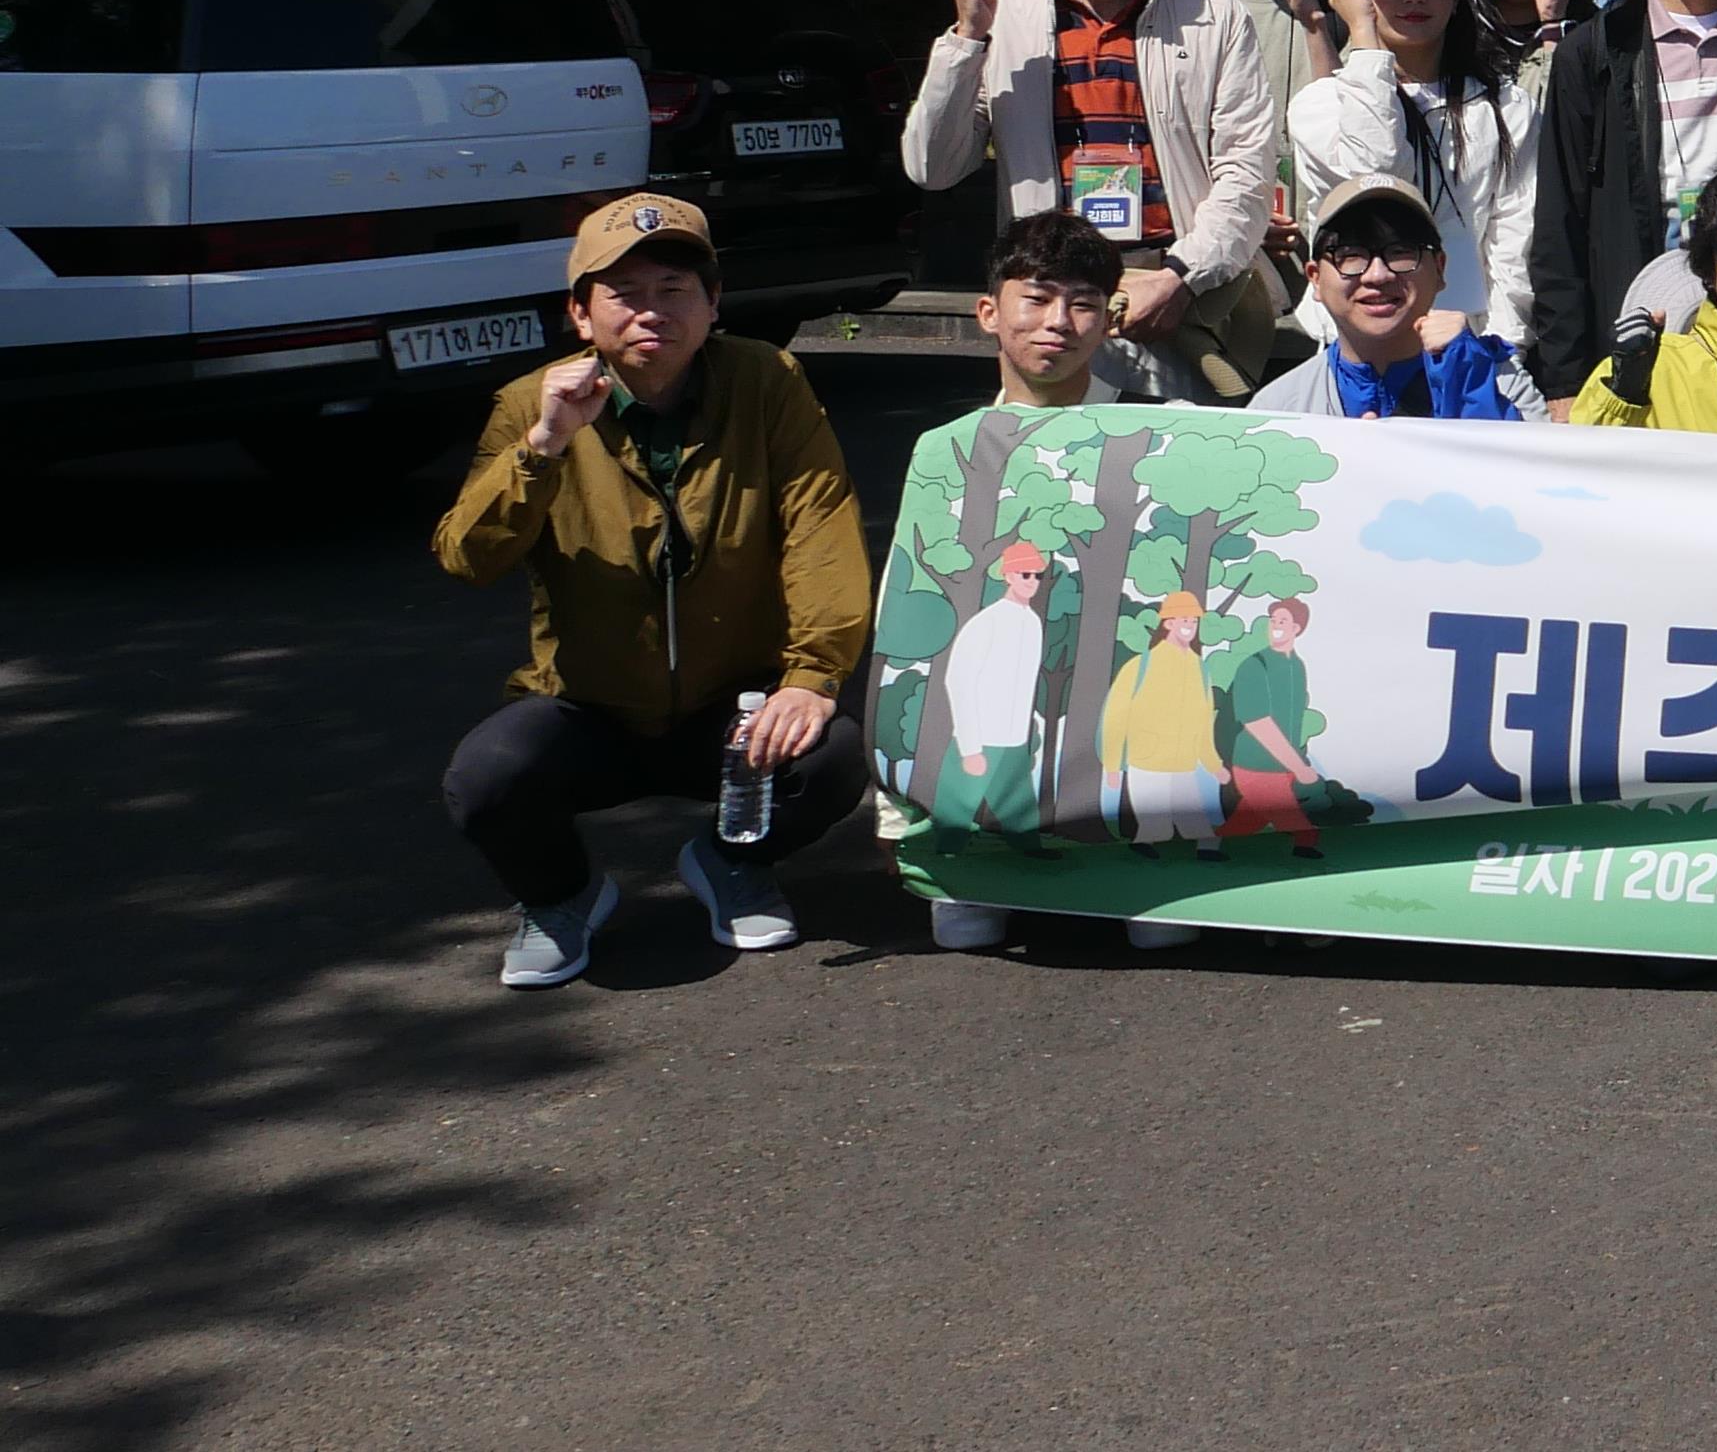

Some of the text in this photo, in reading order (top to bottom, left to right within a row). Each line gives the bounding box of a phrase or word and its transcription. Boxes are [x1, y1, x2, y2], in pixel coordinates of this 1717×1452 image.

[743, 123, 832, 151] 50보 7709
[327, 151, 607, 187] SANTA FE
[477, 315, 532, 351] 4927
[1469, 841, 1584, 899] 일자
